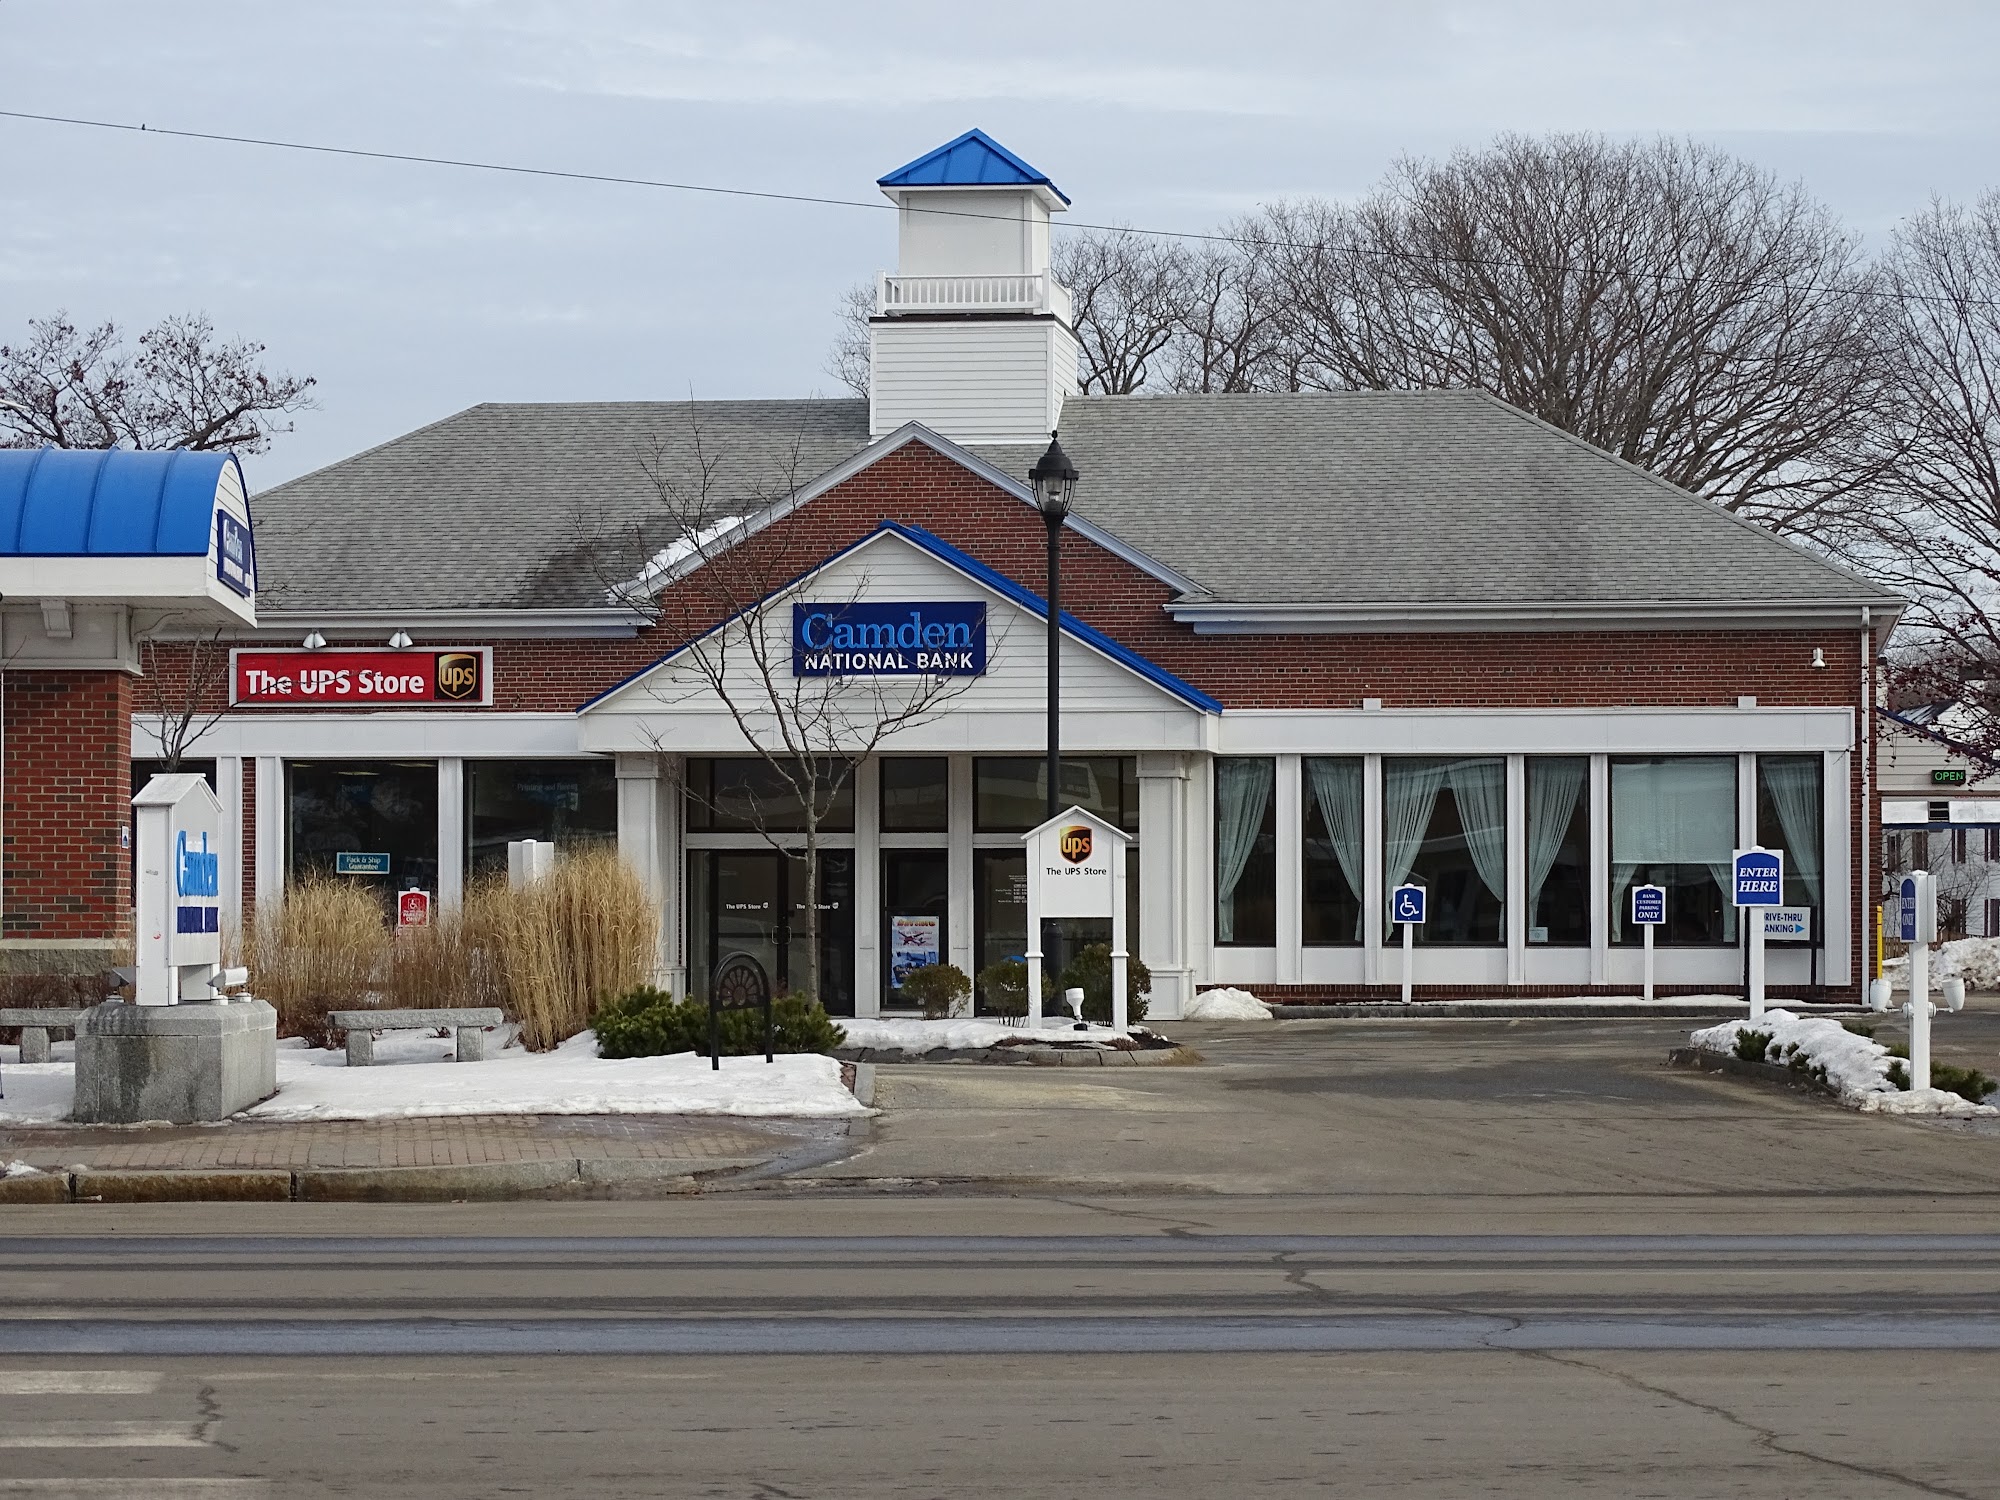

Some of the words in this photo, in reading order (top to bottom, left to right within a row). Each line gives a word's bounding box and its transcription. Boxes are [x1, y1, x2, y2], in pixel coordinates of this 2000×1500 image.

[802, 612, 974, 650] Camden
[805, 652, 909, 670] NATIONAL
[917, 652, 974, 669] BANK
[246, 670, 292, 694] The
[300, 670, 351, 694] UPS
[358, 669, 425, 694] Store
[441, 667, 474, 692] ups
[1935, 772, 1964, 780] OPEN
[1062, 837, 1091, 859] ups
[368, 856, 381, 864] Ship
[1046, 867, 1062, 875] The
[1064, 867, 1081, 875] UPS
[1084, 867, 1107, 875] Store
[1739, 867, 1778, 877] ENTER
[1738, 880, 1778, 892] HERE
[1902, 897, 1915, 909] ENTER
[1764, 913, 1803, 921] RIVE-THRU
[1902, 913, 1914, 925] ONLY
[1764, 924, 1793, 933] ANKING
